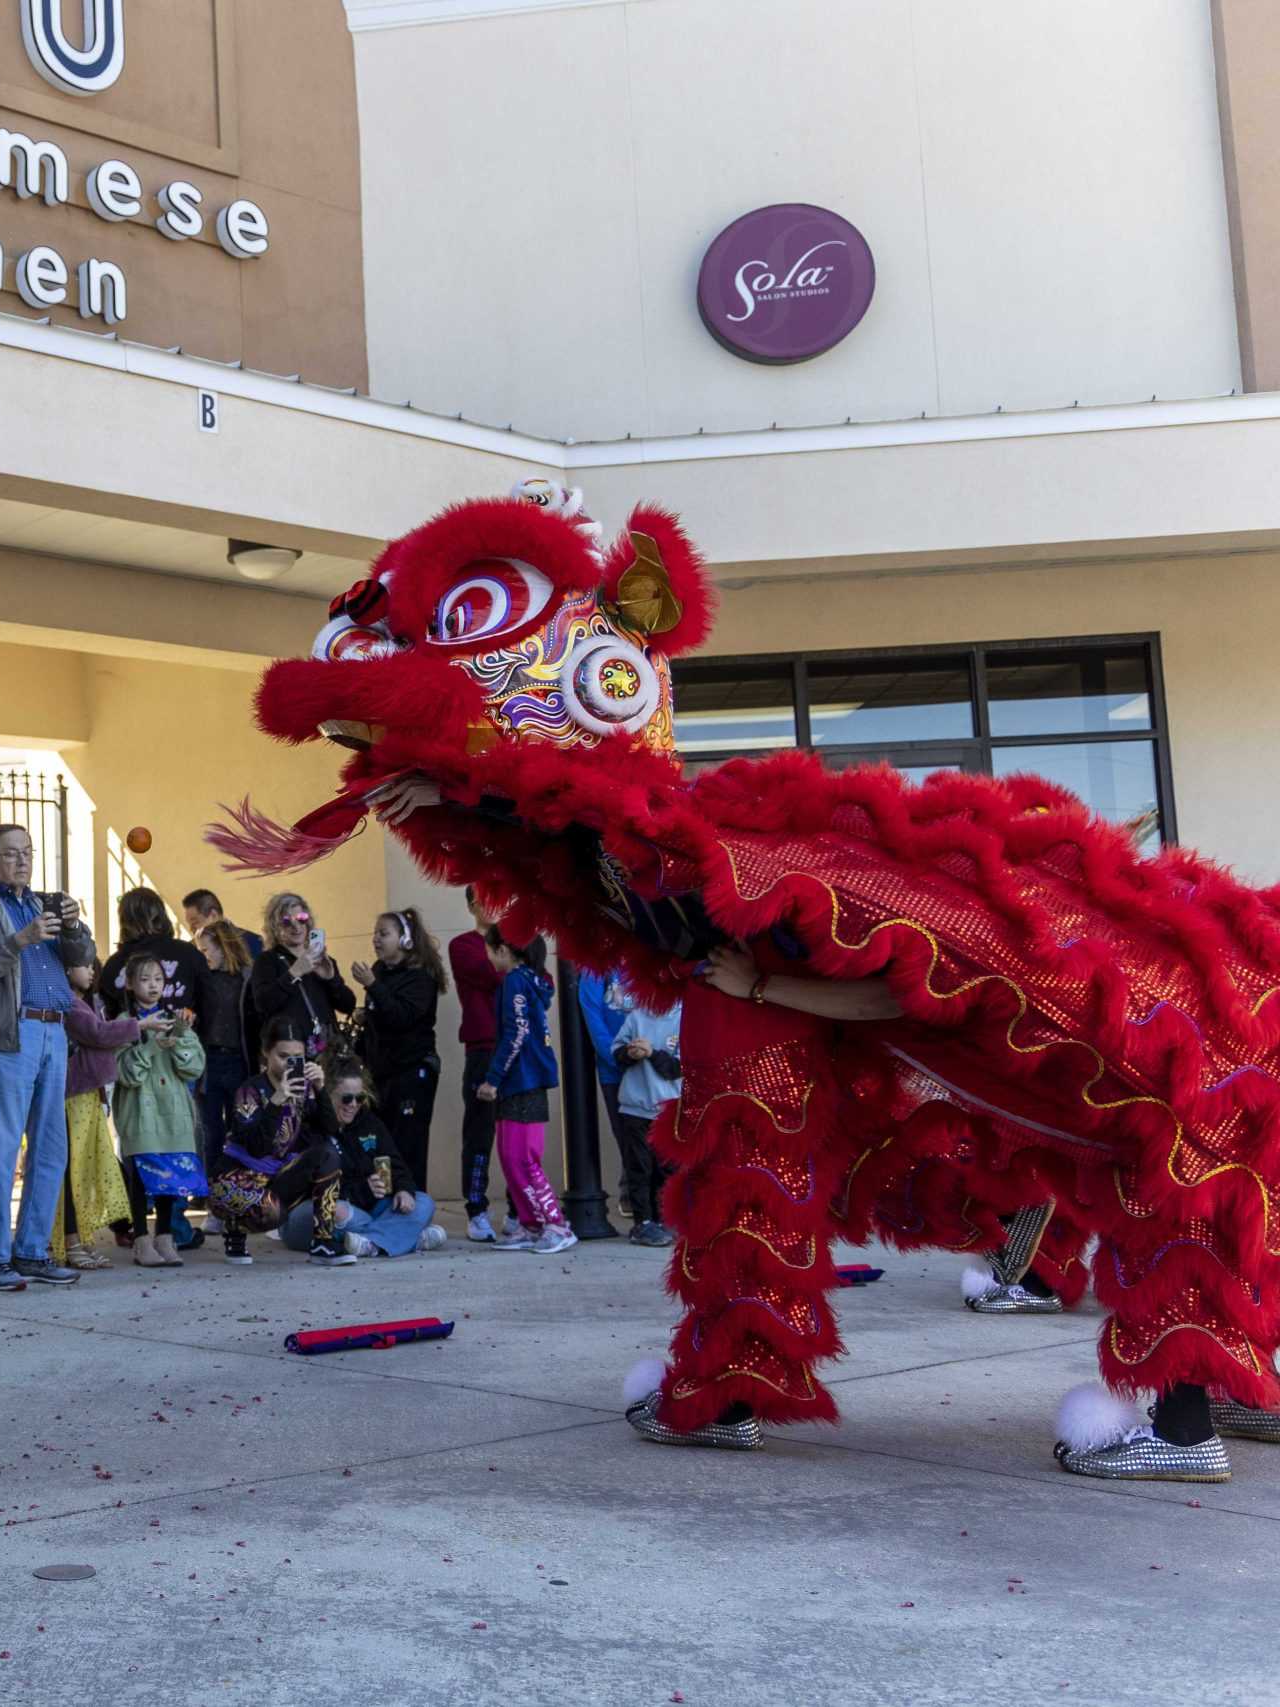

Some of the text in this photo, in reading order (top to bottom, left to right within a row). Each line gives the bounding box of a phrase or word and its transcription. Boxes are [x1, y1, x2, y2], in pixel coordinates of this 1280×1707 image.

[726, 240, 847, 322] Sola
[757, 287, 830, 301] SALON STUDIOS
[202, 393, 216, 428] B
